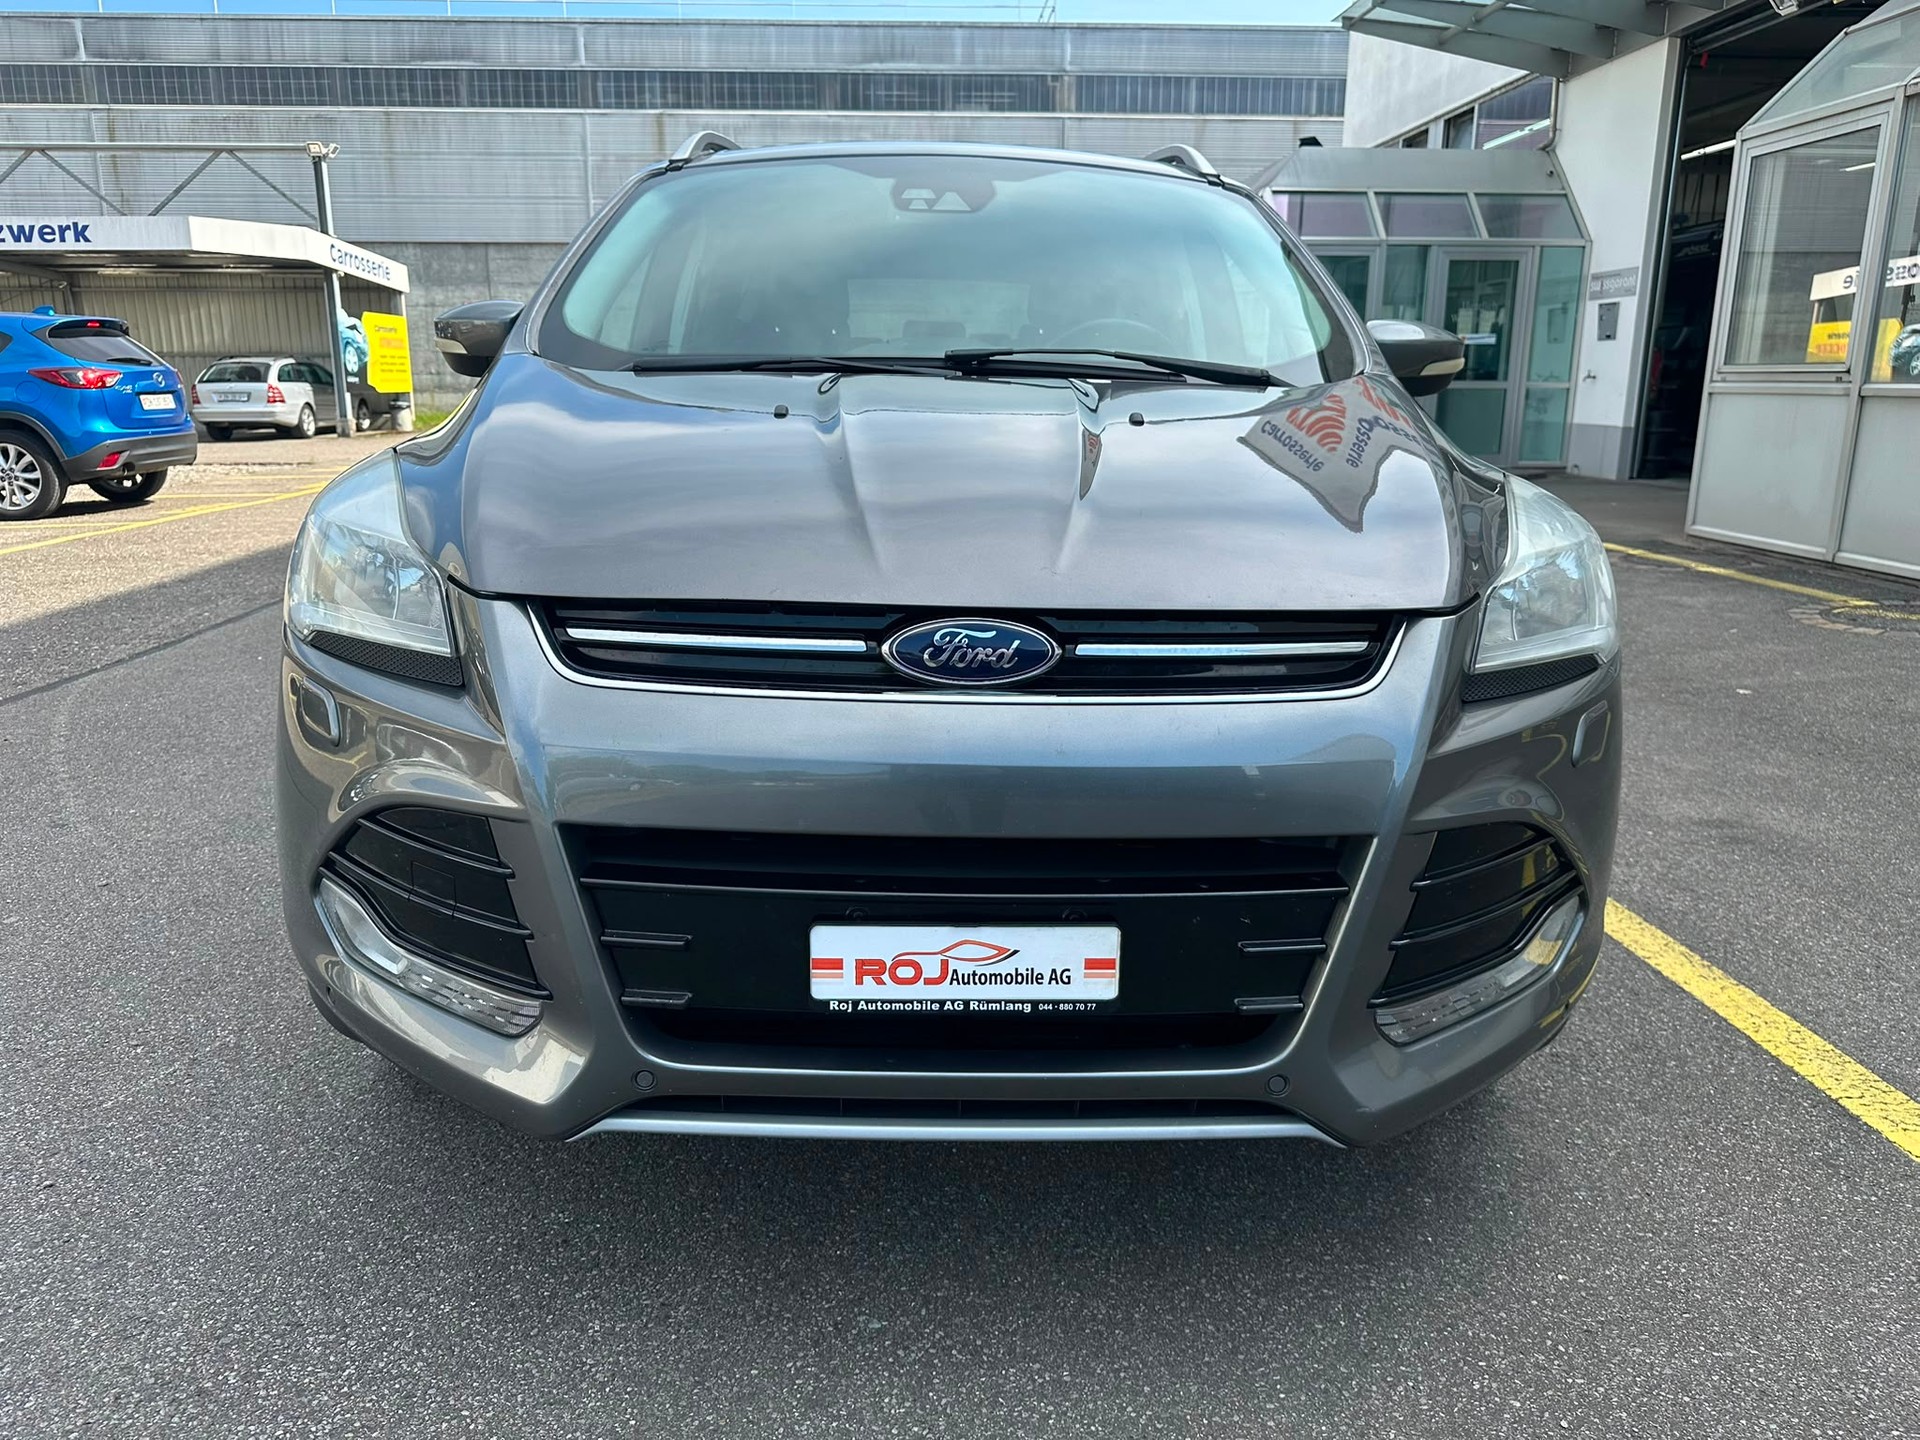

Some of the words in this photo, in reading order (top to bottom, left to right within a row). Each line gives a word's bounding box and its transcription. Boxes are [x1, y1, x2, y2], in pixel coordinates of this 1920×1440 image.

[330, 243, 391, 281] Carrosserie
[923, 628, 1021, 668] Ford
[854, 958, 949, 986] ROJ
[949, 968, 1044, 985] Automobile
[1048, 968, 1072, 985] AG
[829, 1000, 853, 1013] Roj
[857, 1000, 940, 1011] Automobile
[943, 1000, 964, 1011] AG
[969, 1000, 1032, 1013] Rümlang
[1038, 1003, 1053, 1011] 044
[1059, 1003, 1073, 1011] 880
[1075, 1003, 1085, 1011] 70
[1086, 1003, 1096, 1011] 77
